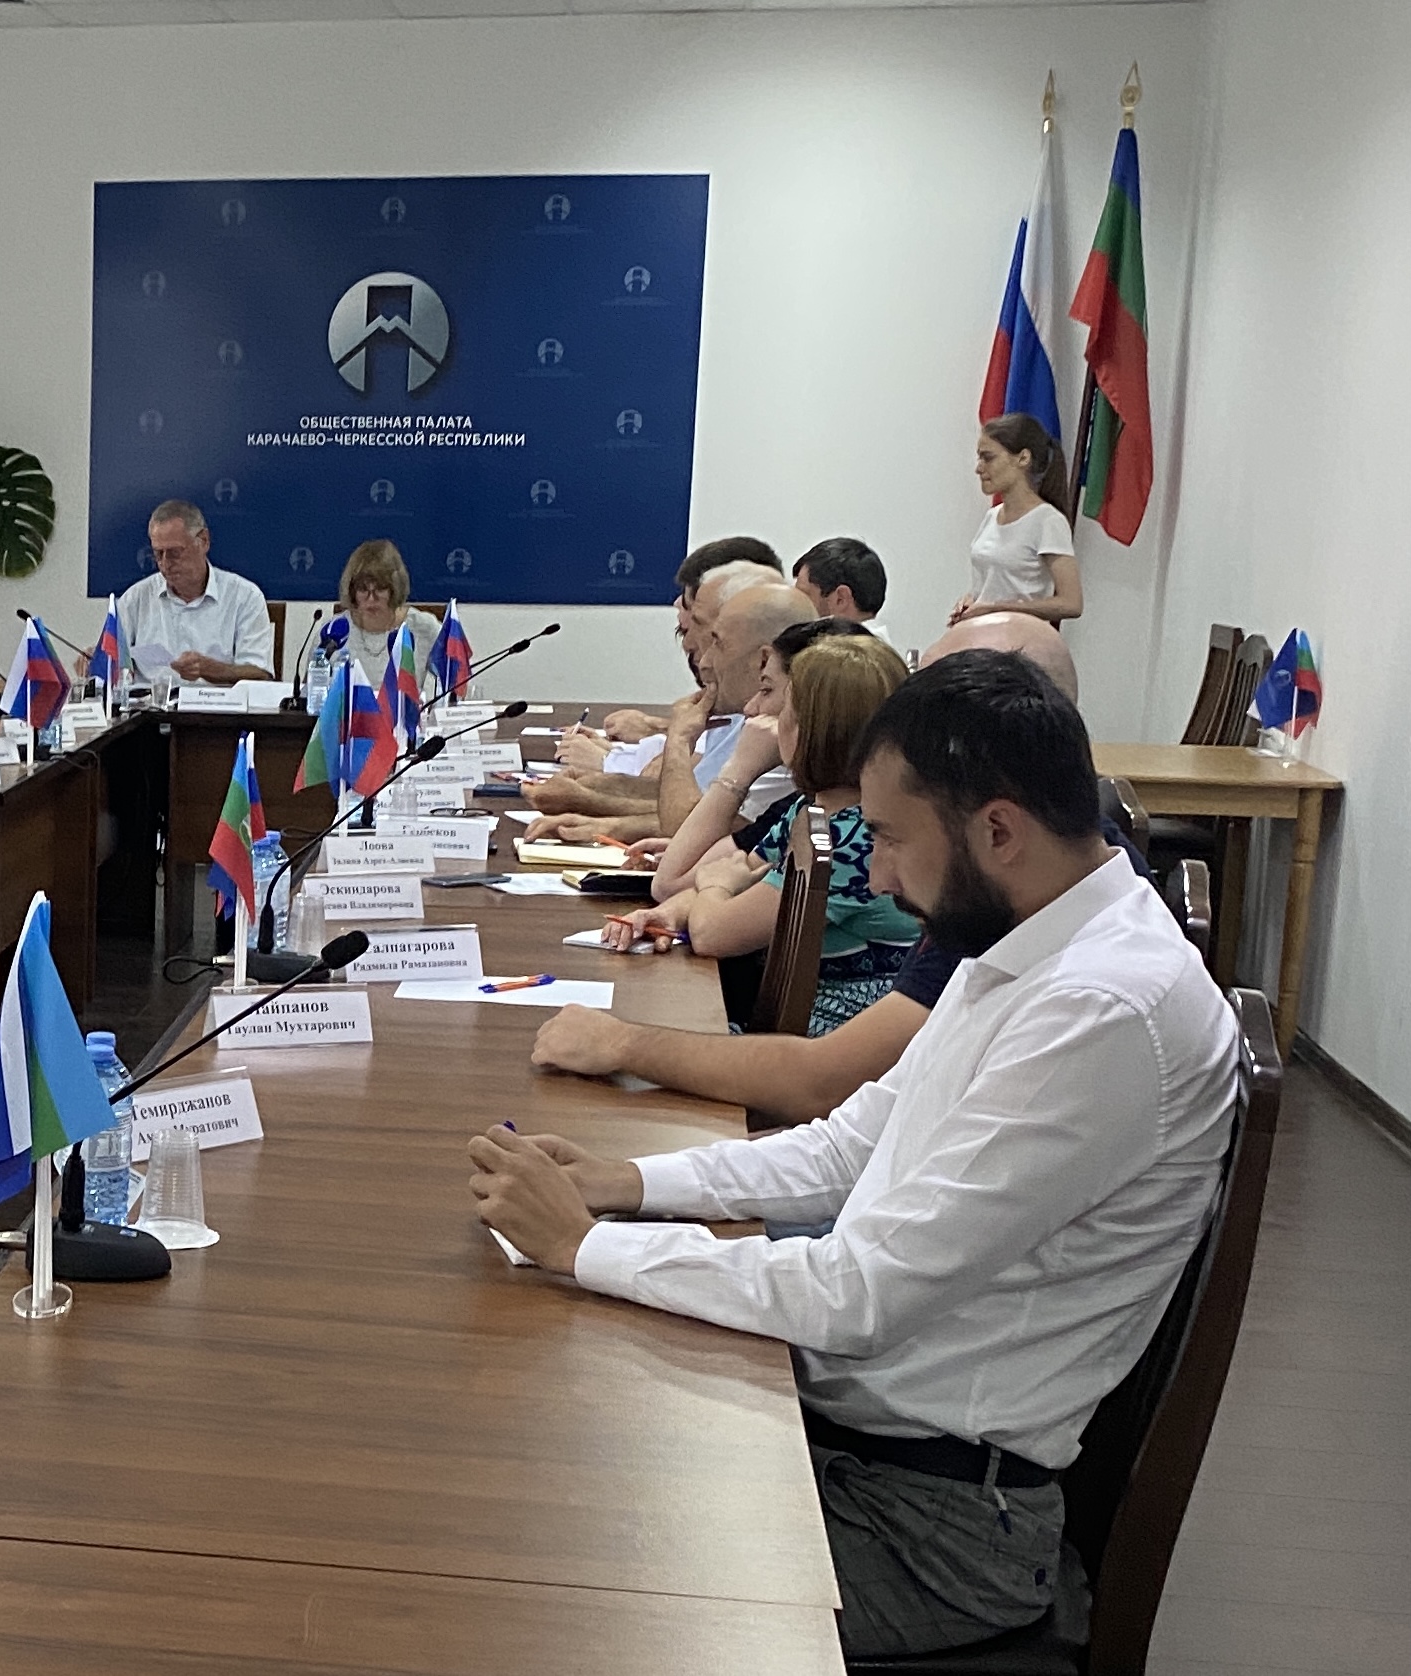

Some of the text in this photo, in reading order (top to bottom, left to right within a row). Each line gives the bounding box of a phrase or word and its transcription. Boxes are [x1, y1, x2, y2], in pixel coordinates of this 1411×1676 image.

[299, 415, 473, 430] ОБЩЕСТВЕННАЯ ПАЛАТА
[246, 430, 526, 447] КАРАЧАЕВО-ЧЕРКЕССКОЙ РЕСПУБЛИКИ
[359, 841, 393, 851] Лоова
[276, 1019, 356, 1034] Мухтарович
